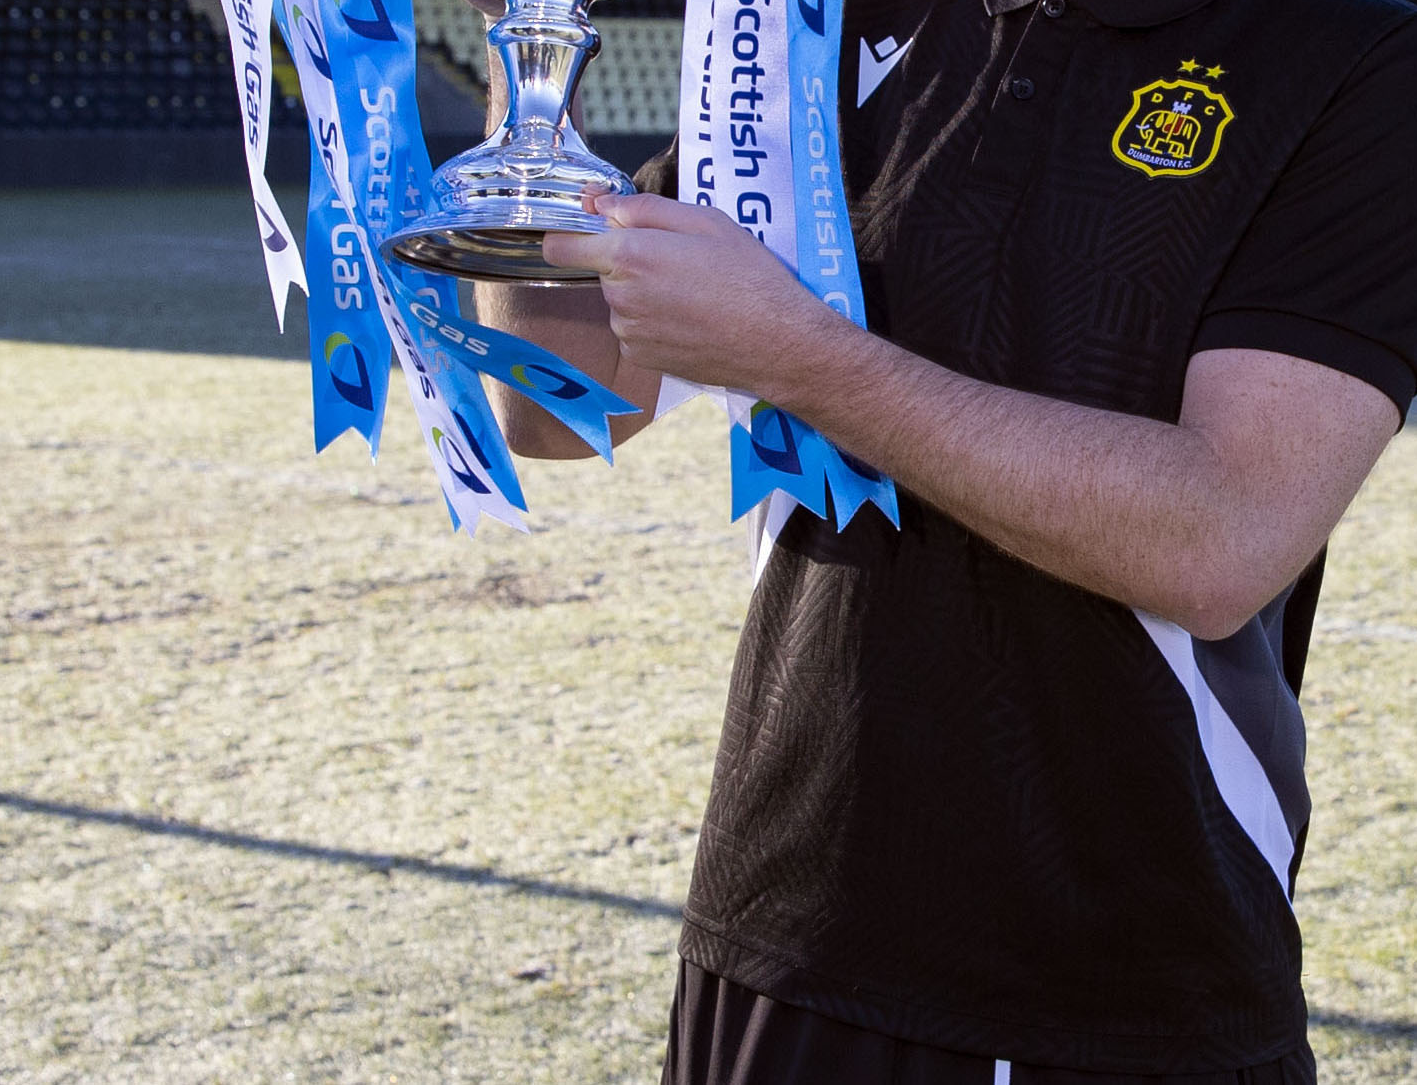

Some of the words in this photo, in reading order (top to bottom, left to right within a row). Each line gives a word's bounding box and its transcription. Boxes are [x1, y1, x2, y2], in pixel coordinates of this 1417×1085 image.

[244, 61, 262, 149] Gas
[802, 76, 845, 277] Scottish
[1127, 148, 1176, 167] DUMBARTON
[331, 223, 368, 310] Gas
[392, 316, 436, 400] Gas
[410, 302, 490, 356] Gas
